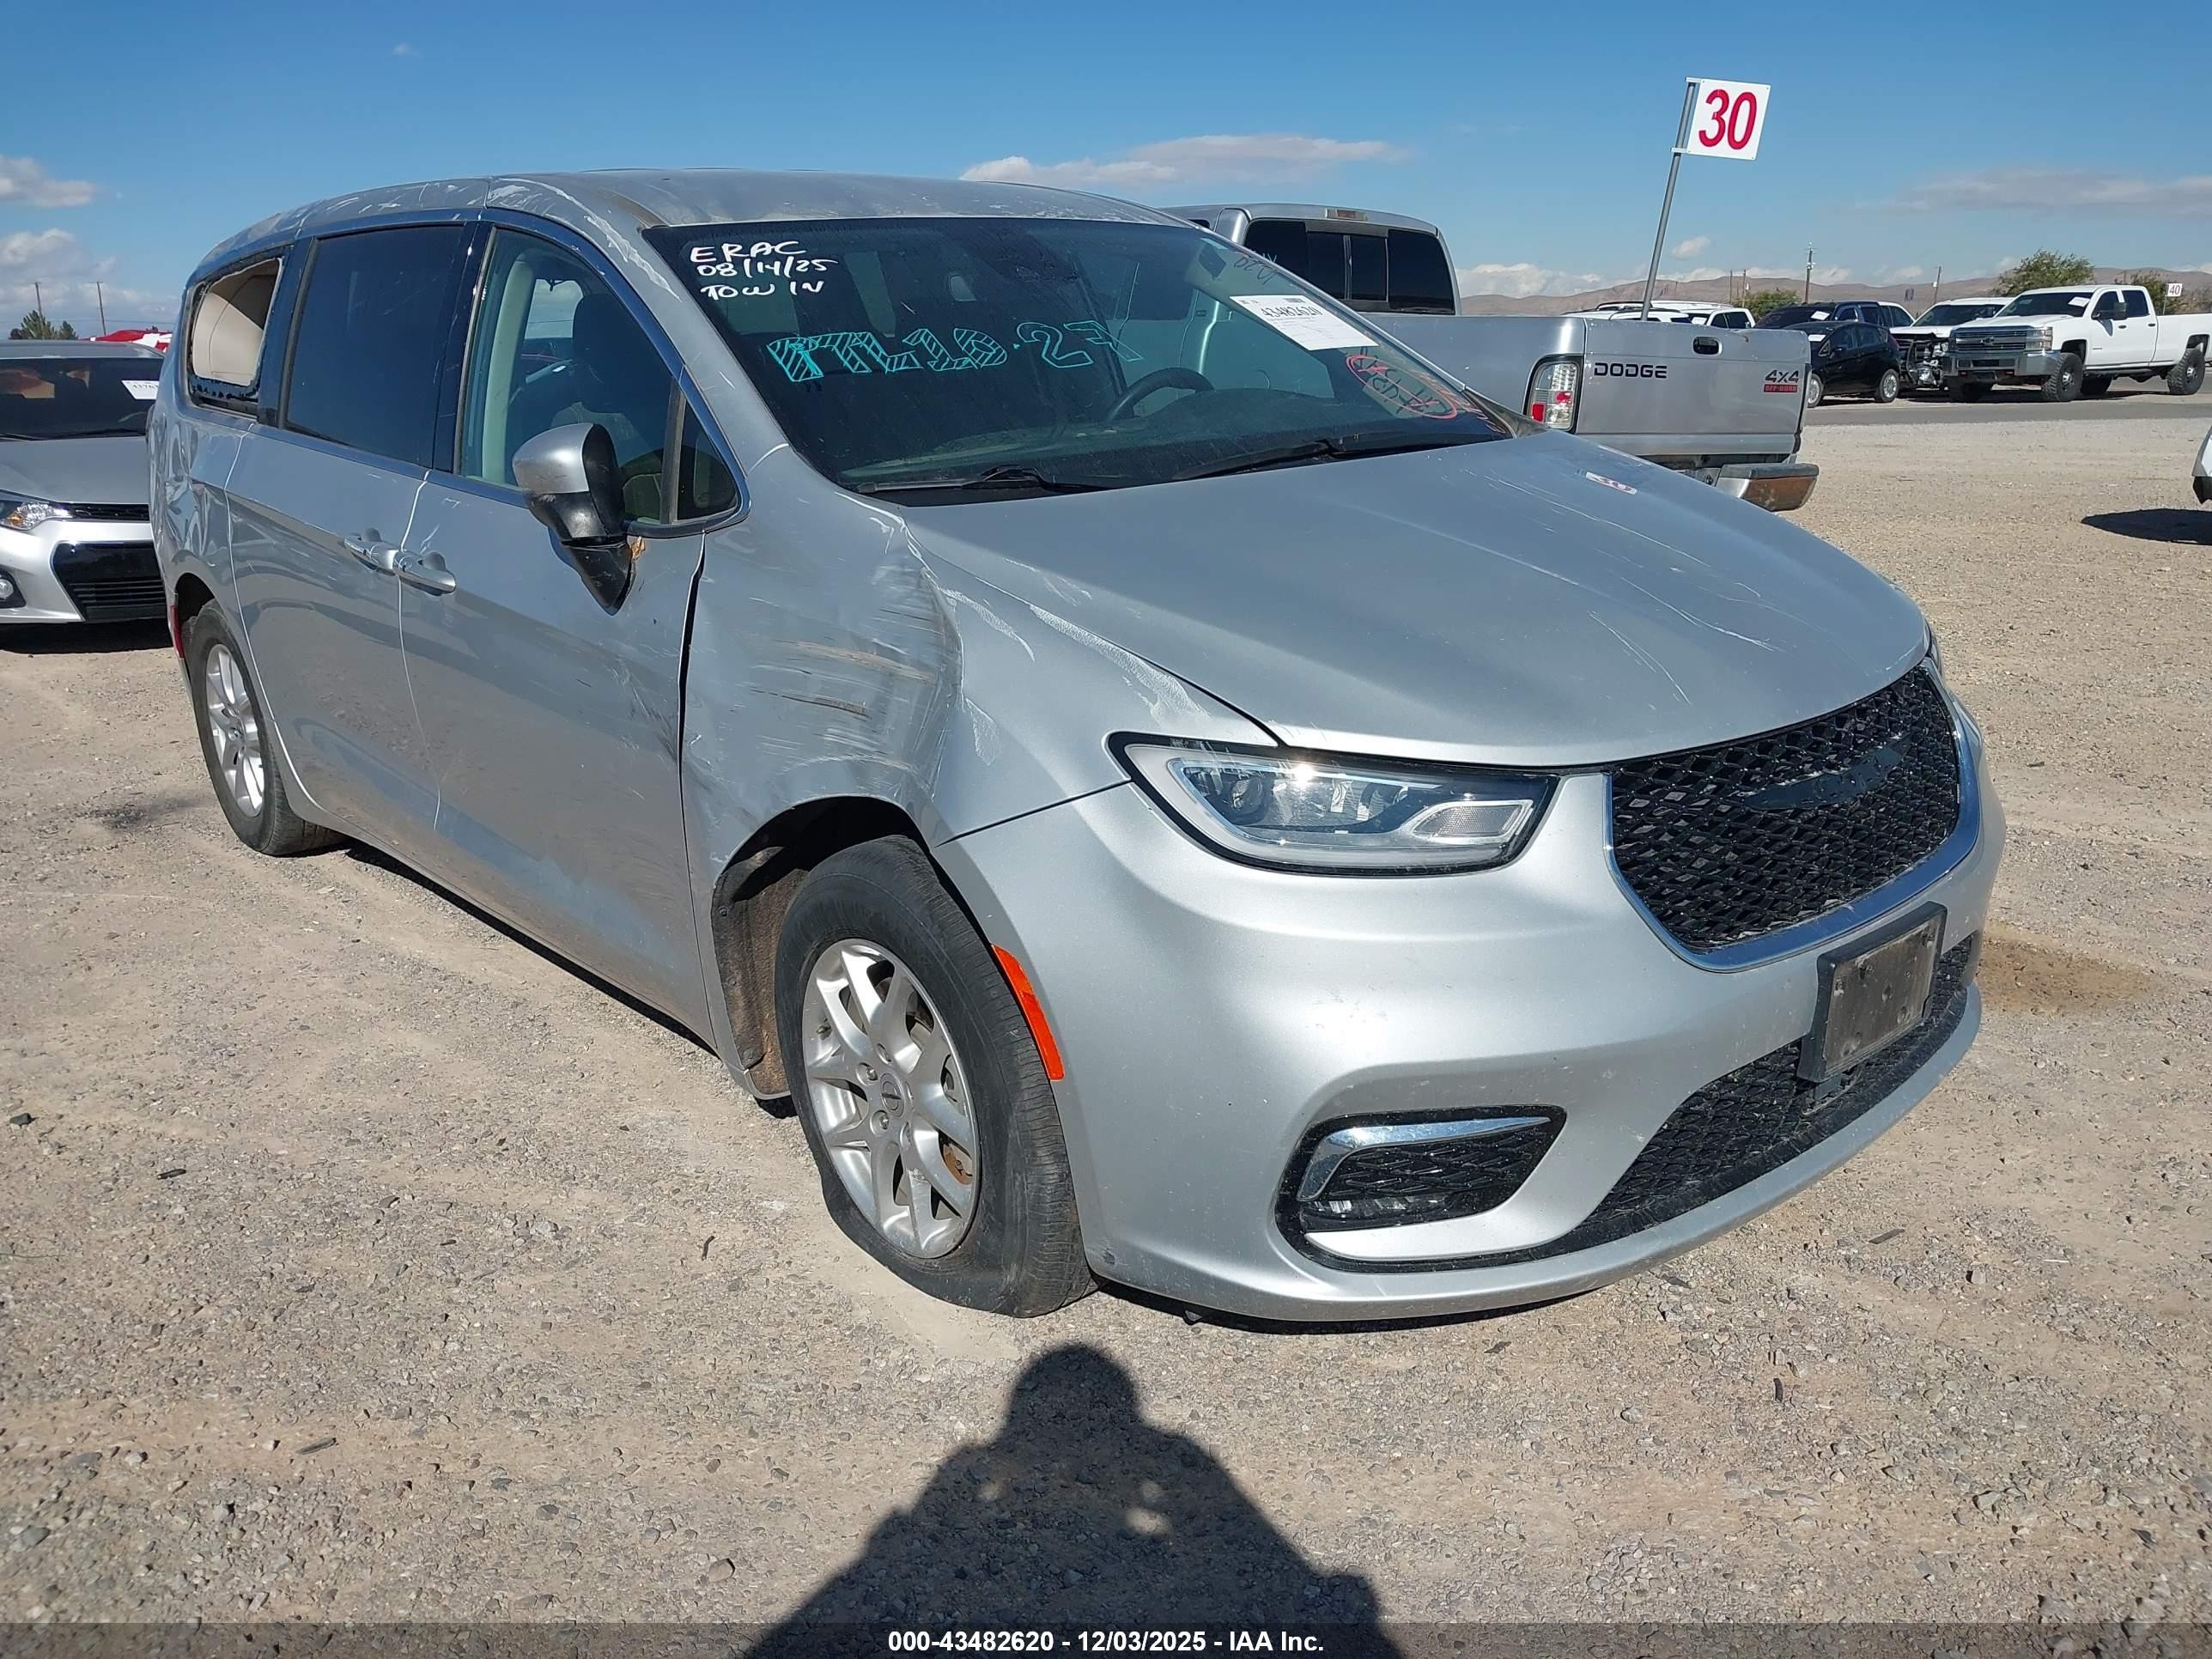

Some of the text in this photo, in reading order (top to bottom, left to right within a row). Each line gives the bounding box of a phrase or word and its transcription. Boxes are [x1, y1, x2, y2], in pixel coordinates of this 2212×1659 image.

[1698, 88, 1758, 150] 30
[690, 240, 807, 263] ERAC
[696, 256, 838, 278] 08/14/25
[700, 280, 824, 301] TOW IN
[2169, 284, 2181, 295] 40
[1593, 362, 1668, 379] DODGE
